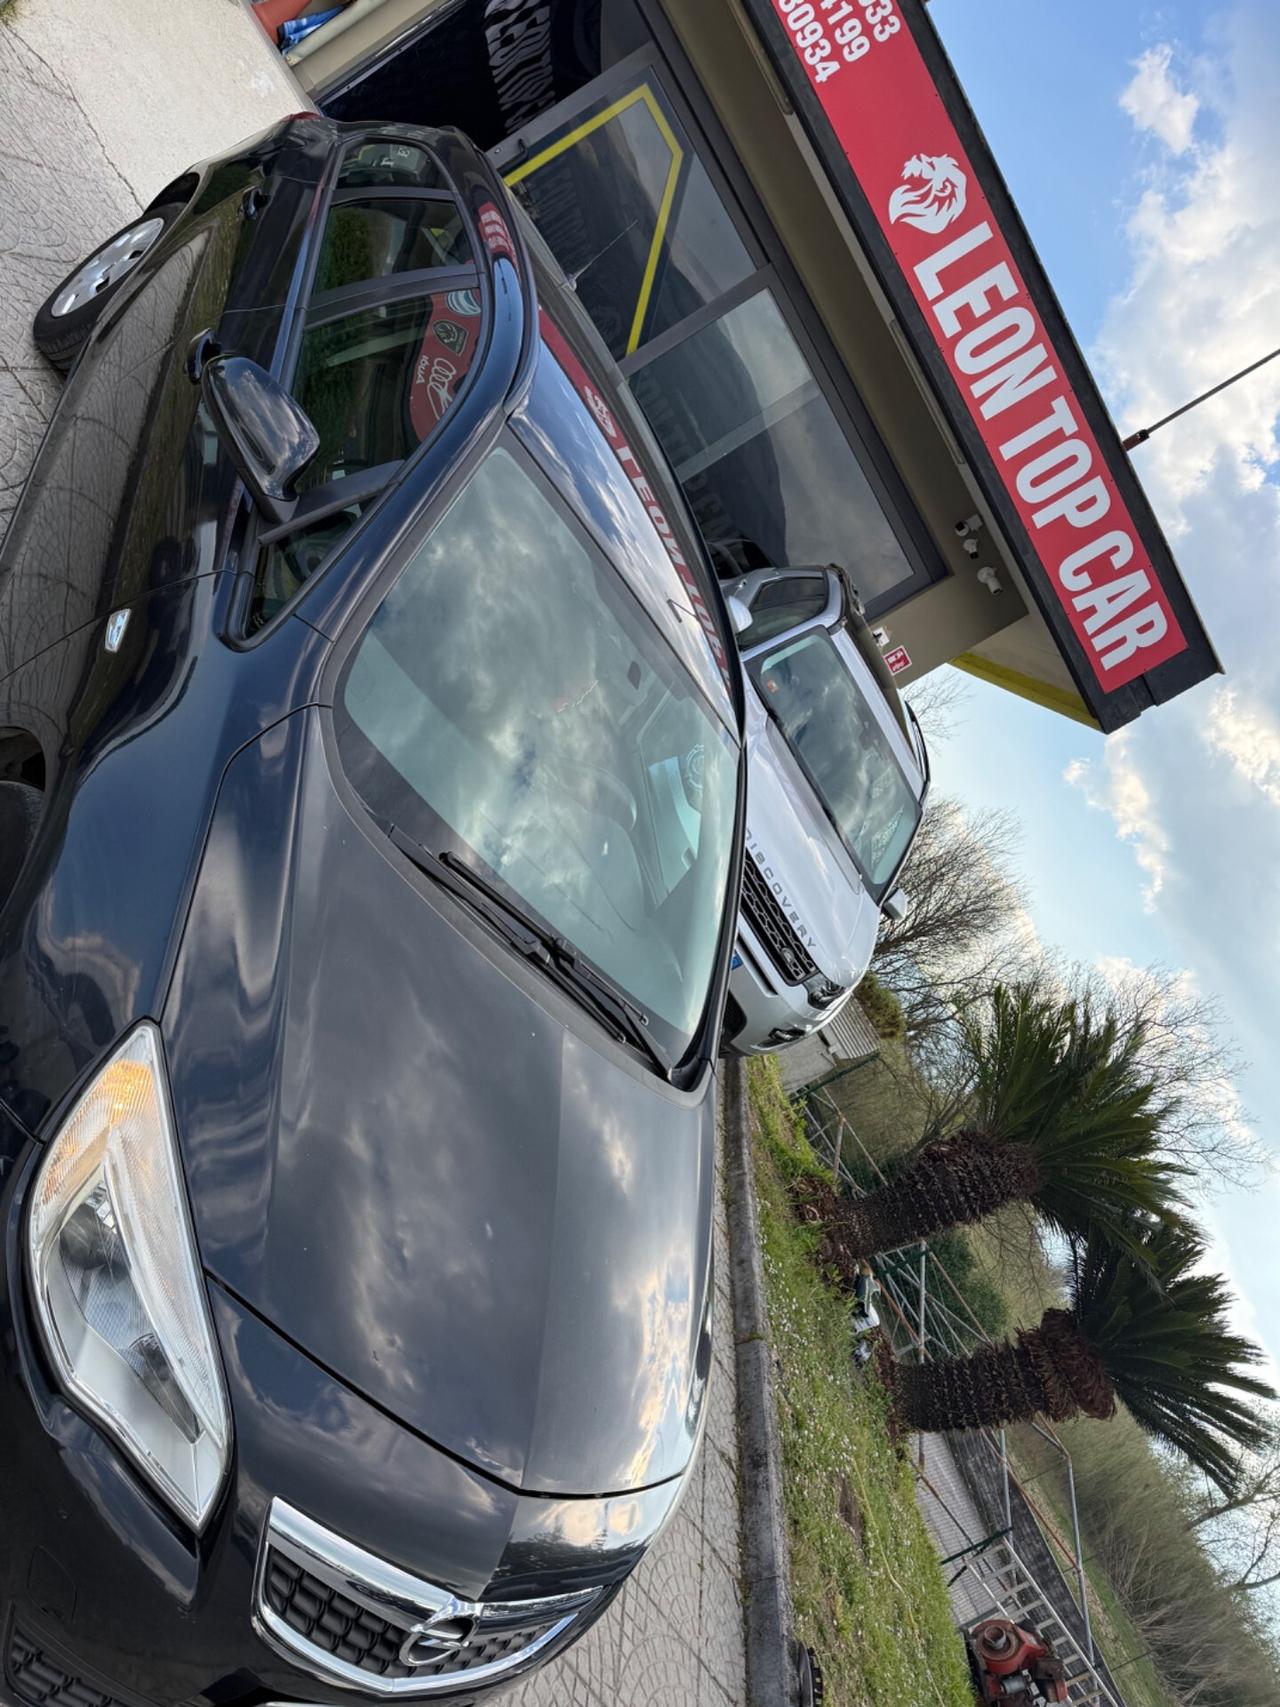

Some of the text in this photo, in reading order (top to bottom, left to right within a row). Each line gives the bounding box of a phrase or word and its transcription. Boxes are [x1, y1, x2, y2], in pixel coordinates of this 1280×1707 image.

[858, 0, 901, 42] 33
[913, 221, 1168, 671] LEON TOP CAR
